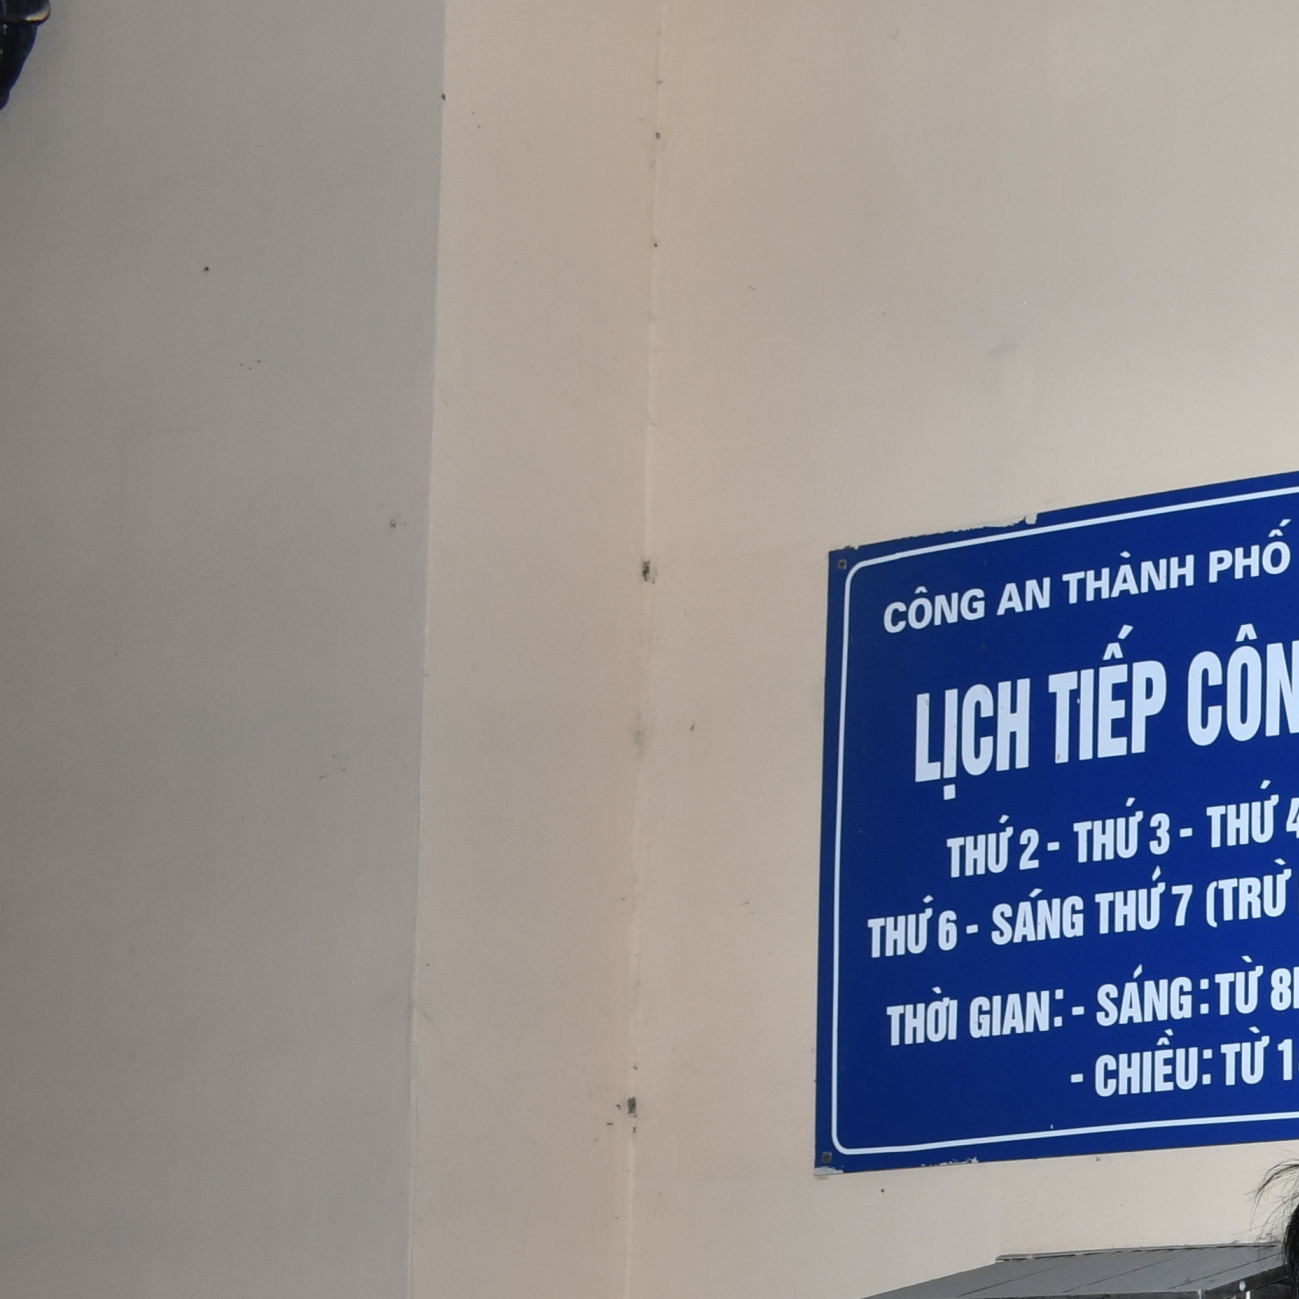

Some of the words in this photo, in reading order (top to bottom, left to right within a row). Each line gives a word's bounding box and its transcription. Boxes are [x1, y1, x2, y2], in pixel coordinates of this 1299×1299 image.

[884, 586, 985, 633] CÔNG
[997, 577, 1050, 615] AN
[1062, 551, 1194, 603] THÀNH
[1209, 519, 1290, 582] PHỐ
[915, 678, 1030, 800] LỊCH
[1049, 625, 1166, 763] TIẾP
[947, 815, 1013, 877] THỨ
[1020, 829, 1039, 870] 2
[1074, 798, 1143, 862] THỨ
[1150, 813, 1170, 854] 3
[1207, 780, 1279, 847] THỨ
[868, 895, 933, 958] THỨ
[938, 910, 957, 950] 6
[992, 888, 1083, 945] SÁNG
[1095, 866, 1165, 934] THỨ
[1172, 885, 1192, 926] 7
[1206, 859, 1291, 927] (TRỪ
[887, 987, 957, 1045] THỜI
[970, 989, 1063, 1038] GIAN:
[1221, 1027, 1269, 1085] TỪ
